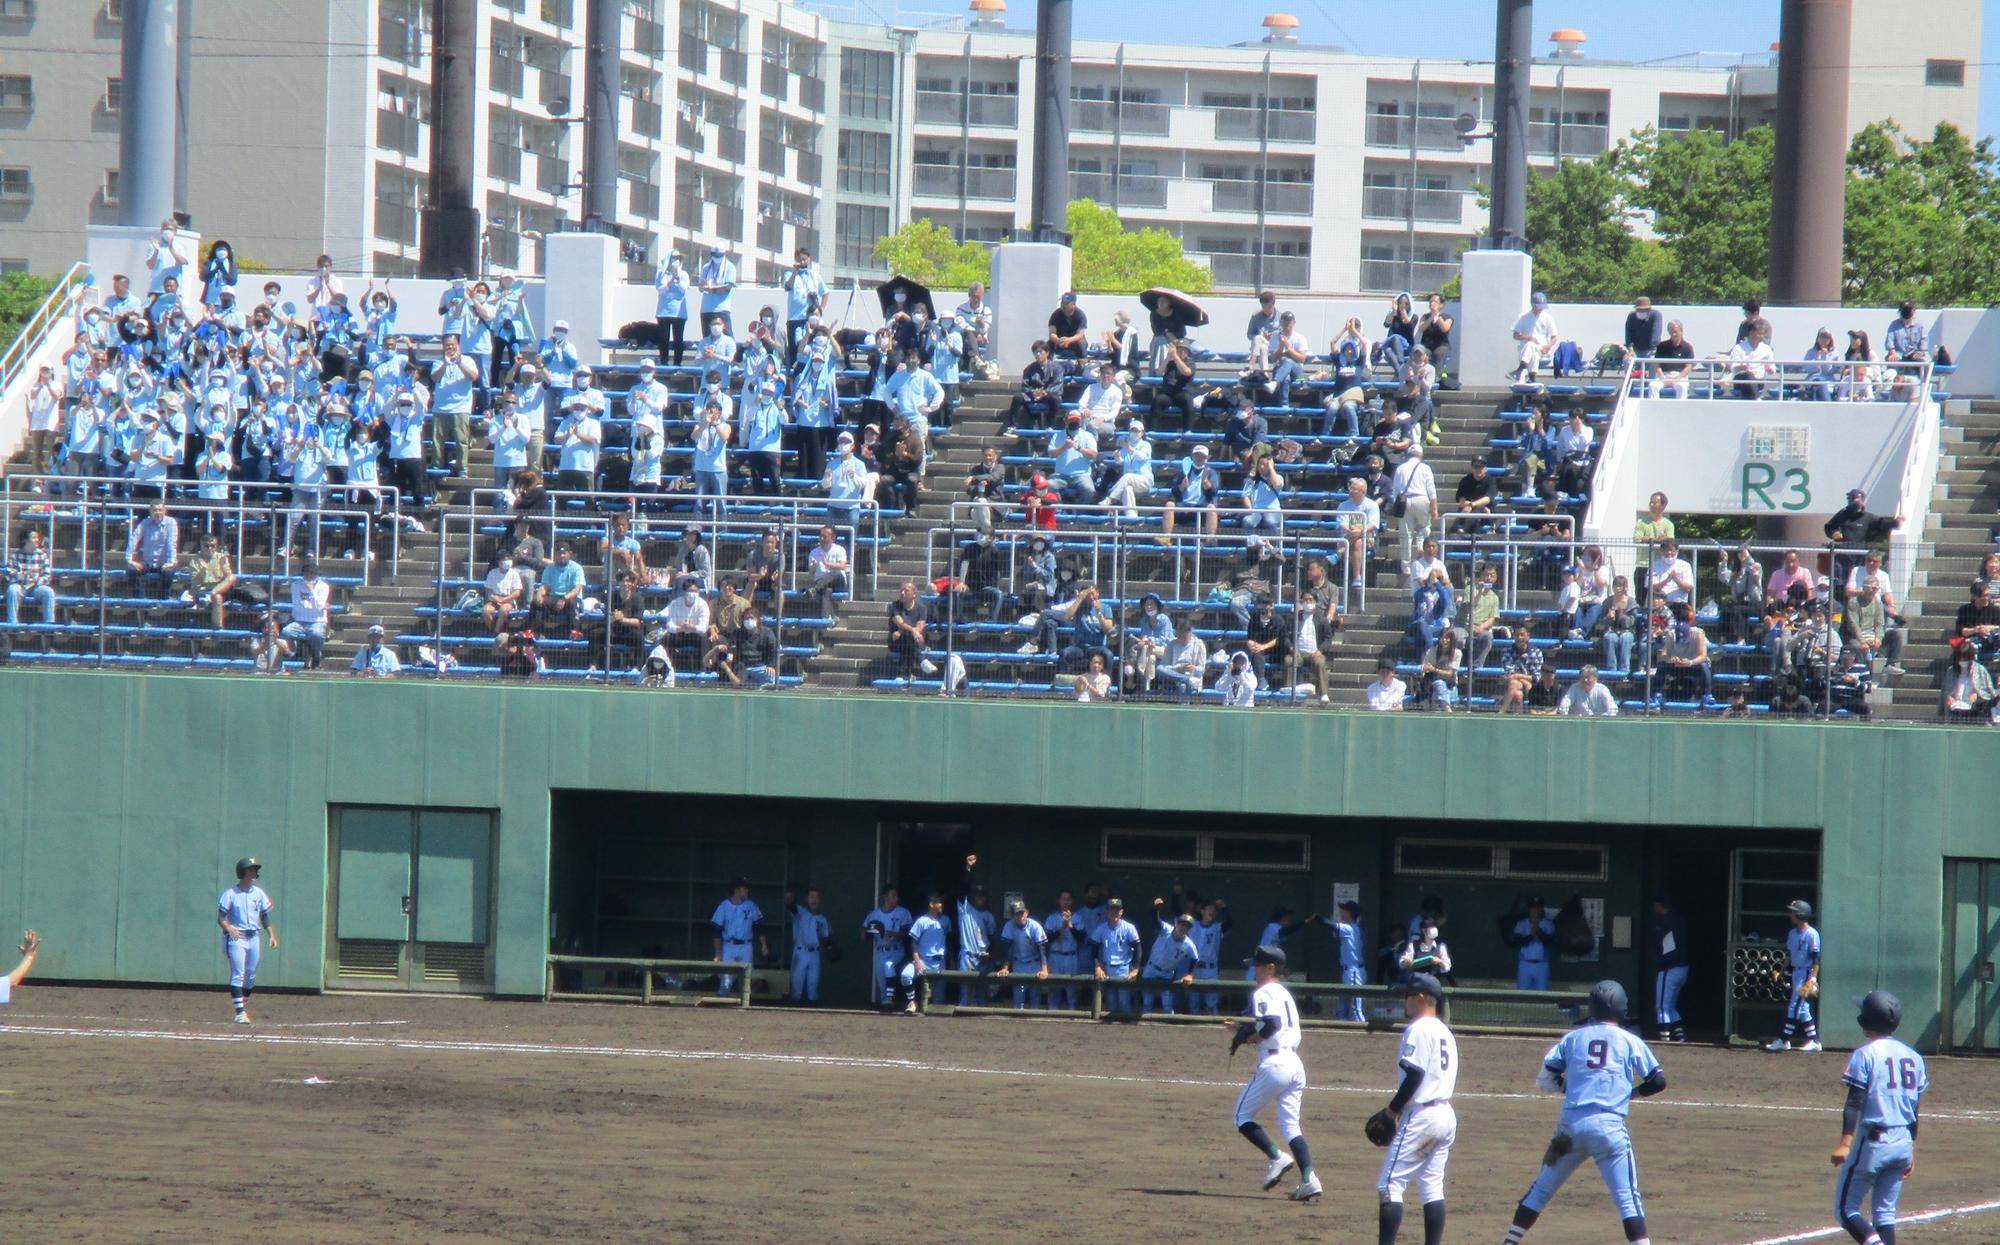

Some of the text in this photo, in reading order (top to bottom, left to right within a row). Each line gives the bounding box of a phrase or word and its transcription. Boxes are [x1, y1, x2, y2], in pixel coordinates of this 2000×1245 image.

[1741, 462, 1811, 511] R3
[1439, 1039, 1450, 1071] 5
[1586, 1039, 1608, 1069] 9
[1885, 1057, 1916, 1090] 16
